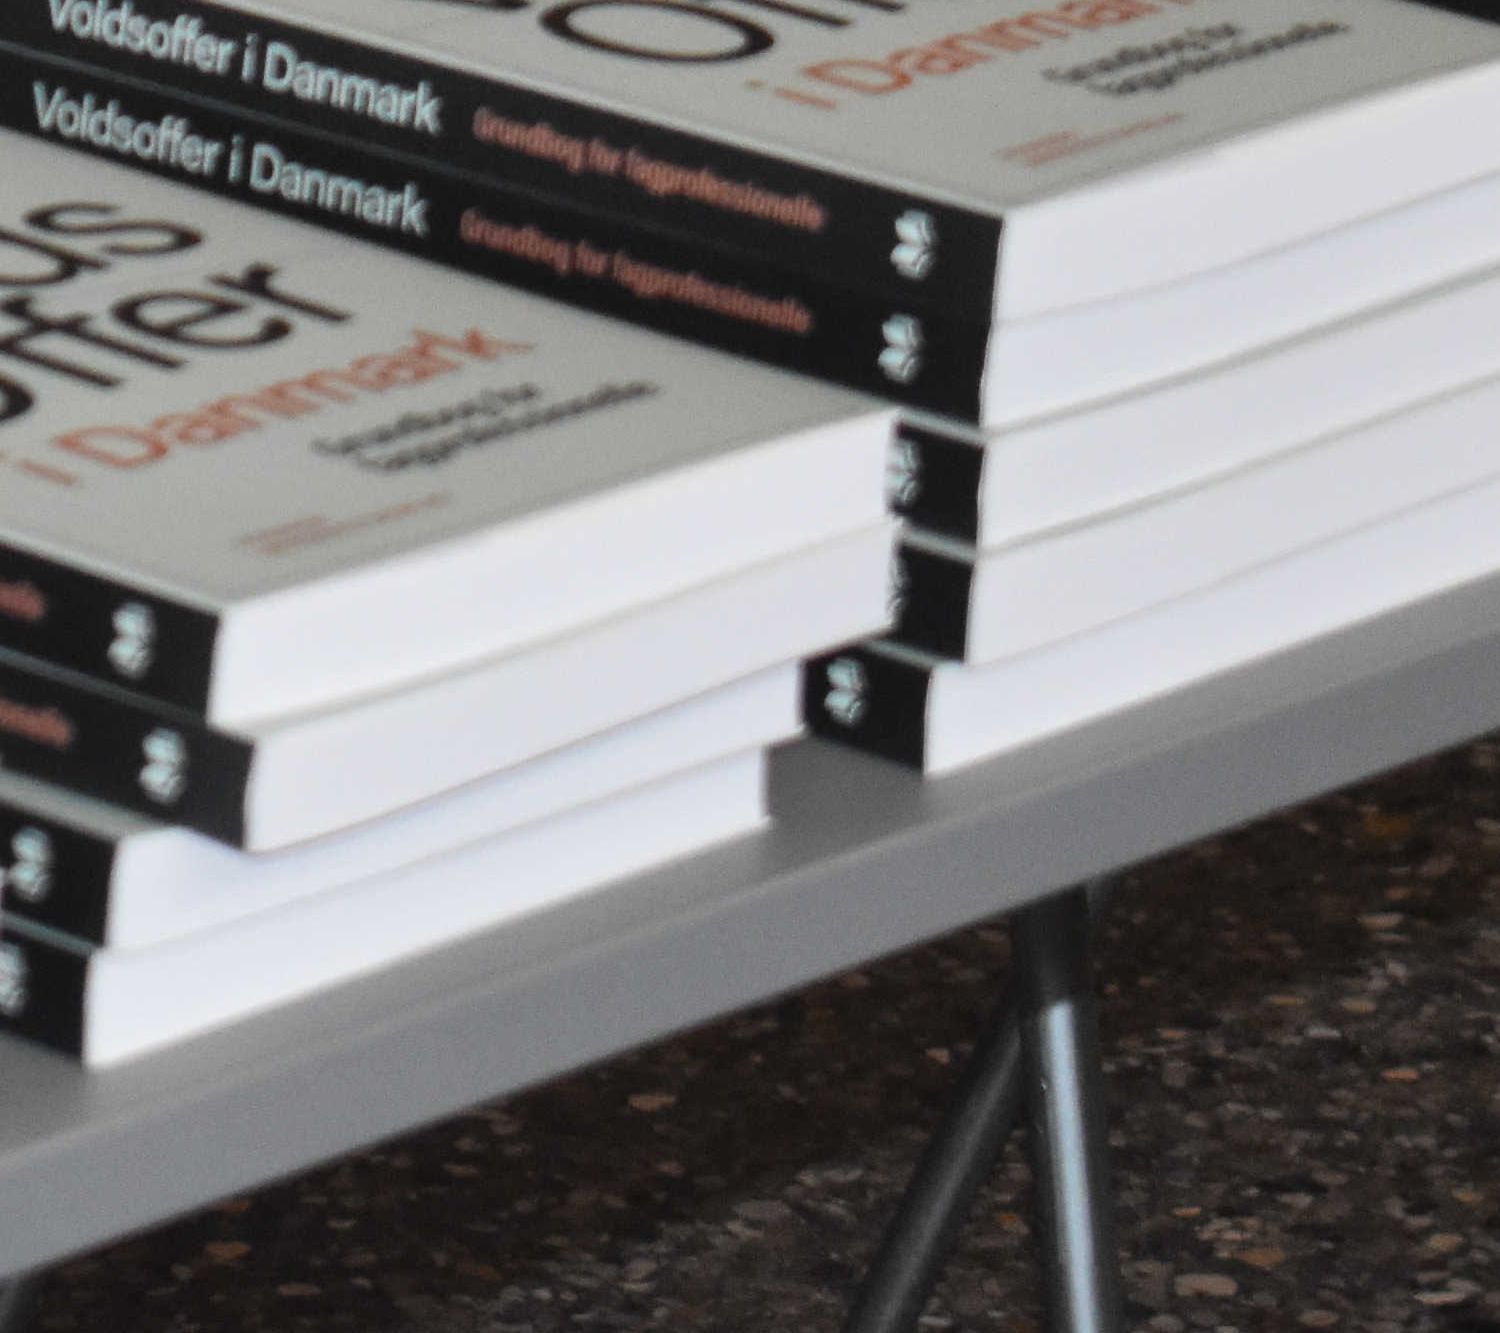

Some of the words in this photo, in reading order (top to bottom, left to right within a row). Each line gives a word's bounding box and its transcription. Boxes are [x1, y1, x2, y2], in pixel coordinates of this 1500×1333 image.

[241, 34, 257, 84] i
[262, 40, 443, 135] Danmark
[31, 80, 222, 173] Voldsoffer
[227, 136, 243, 184] i
[248, 143, 430, 239] Danmark
[51, 328, 536, 471] Danmark
